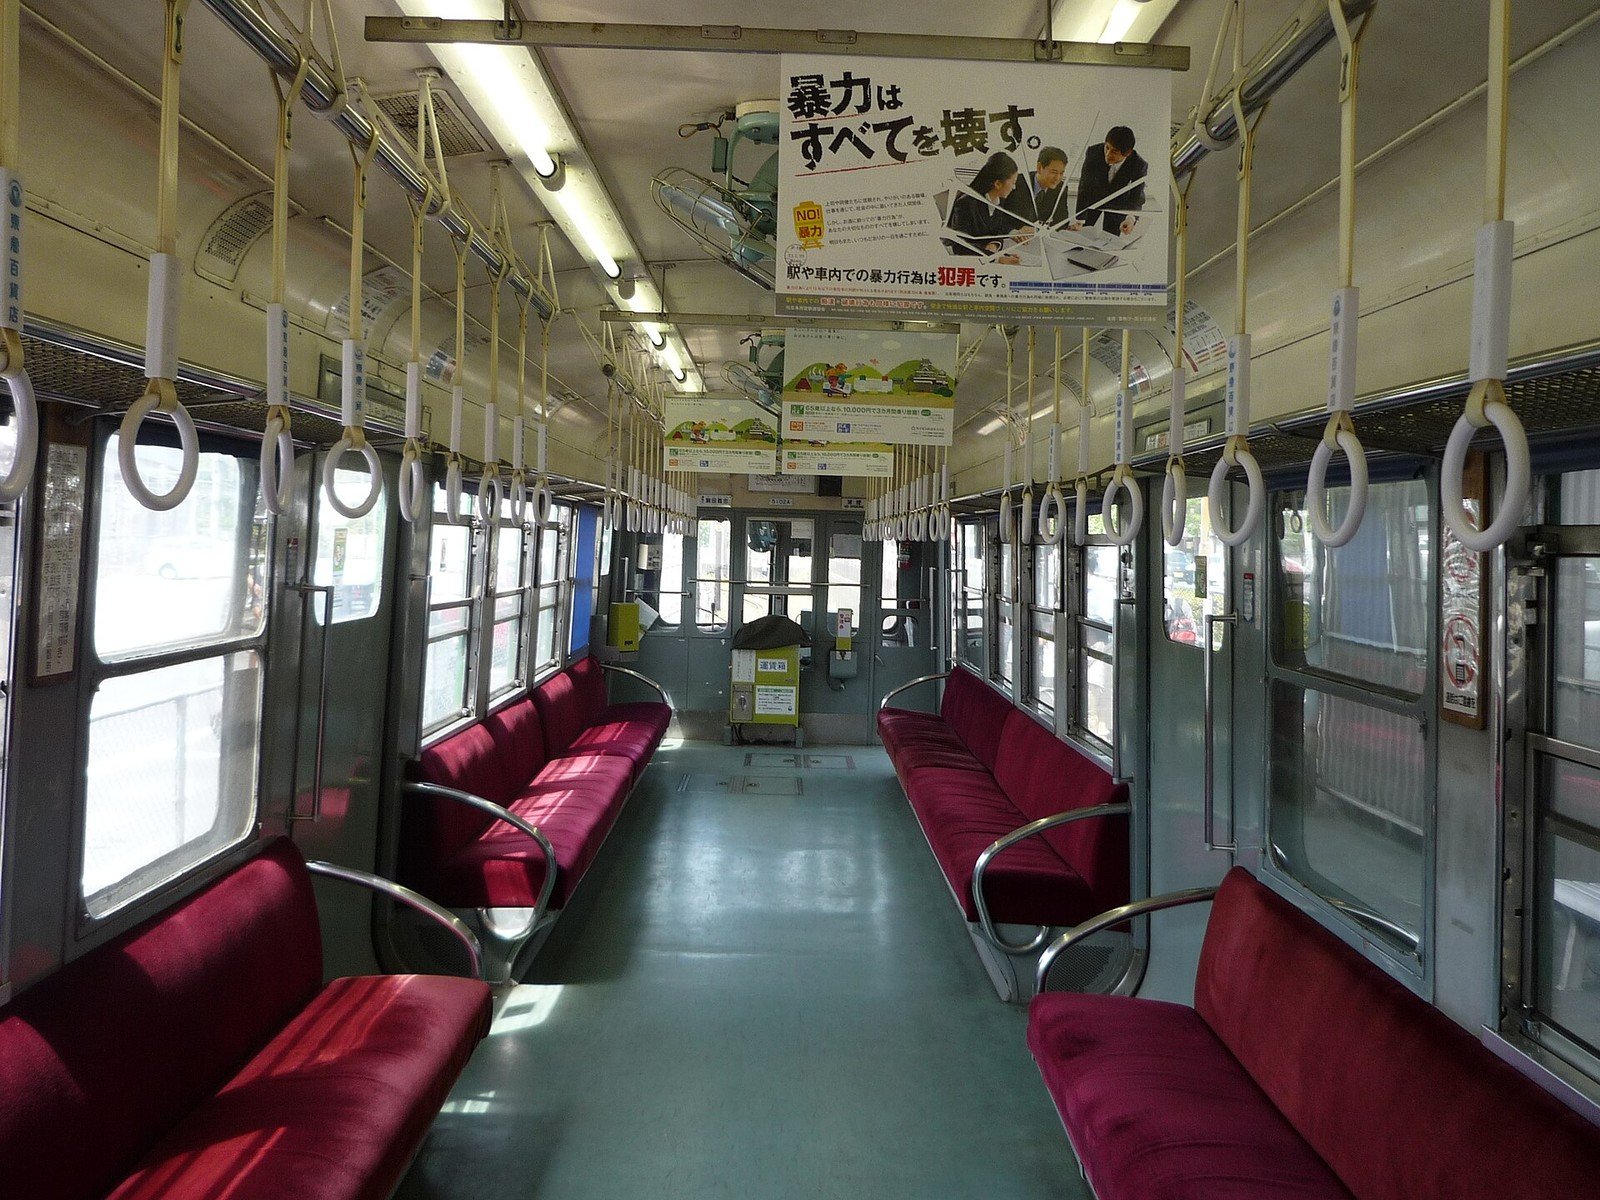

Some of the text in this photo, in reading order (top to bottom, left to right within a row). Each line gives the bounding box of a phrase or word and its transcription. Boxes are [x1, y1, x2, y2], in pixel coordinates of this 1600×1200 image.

[787, 71, 904, 119] 暴力は
[790, 105, 1042, 171] すべてを壊す。
[796, 208, 821, 221] NO!
[798, 225, 822, 239] 暴力
[786, 265, 1006, 289] 駅や車内での暴力行為は犯罪です。
[760, 661, 786, 671] 運賃箱
